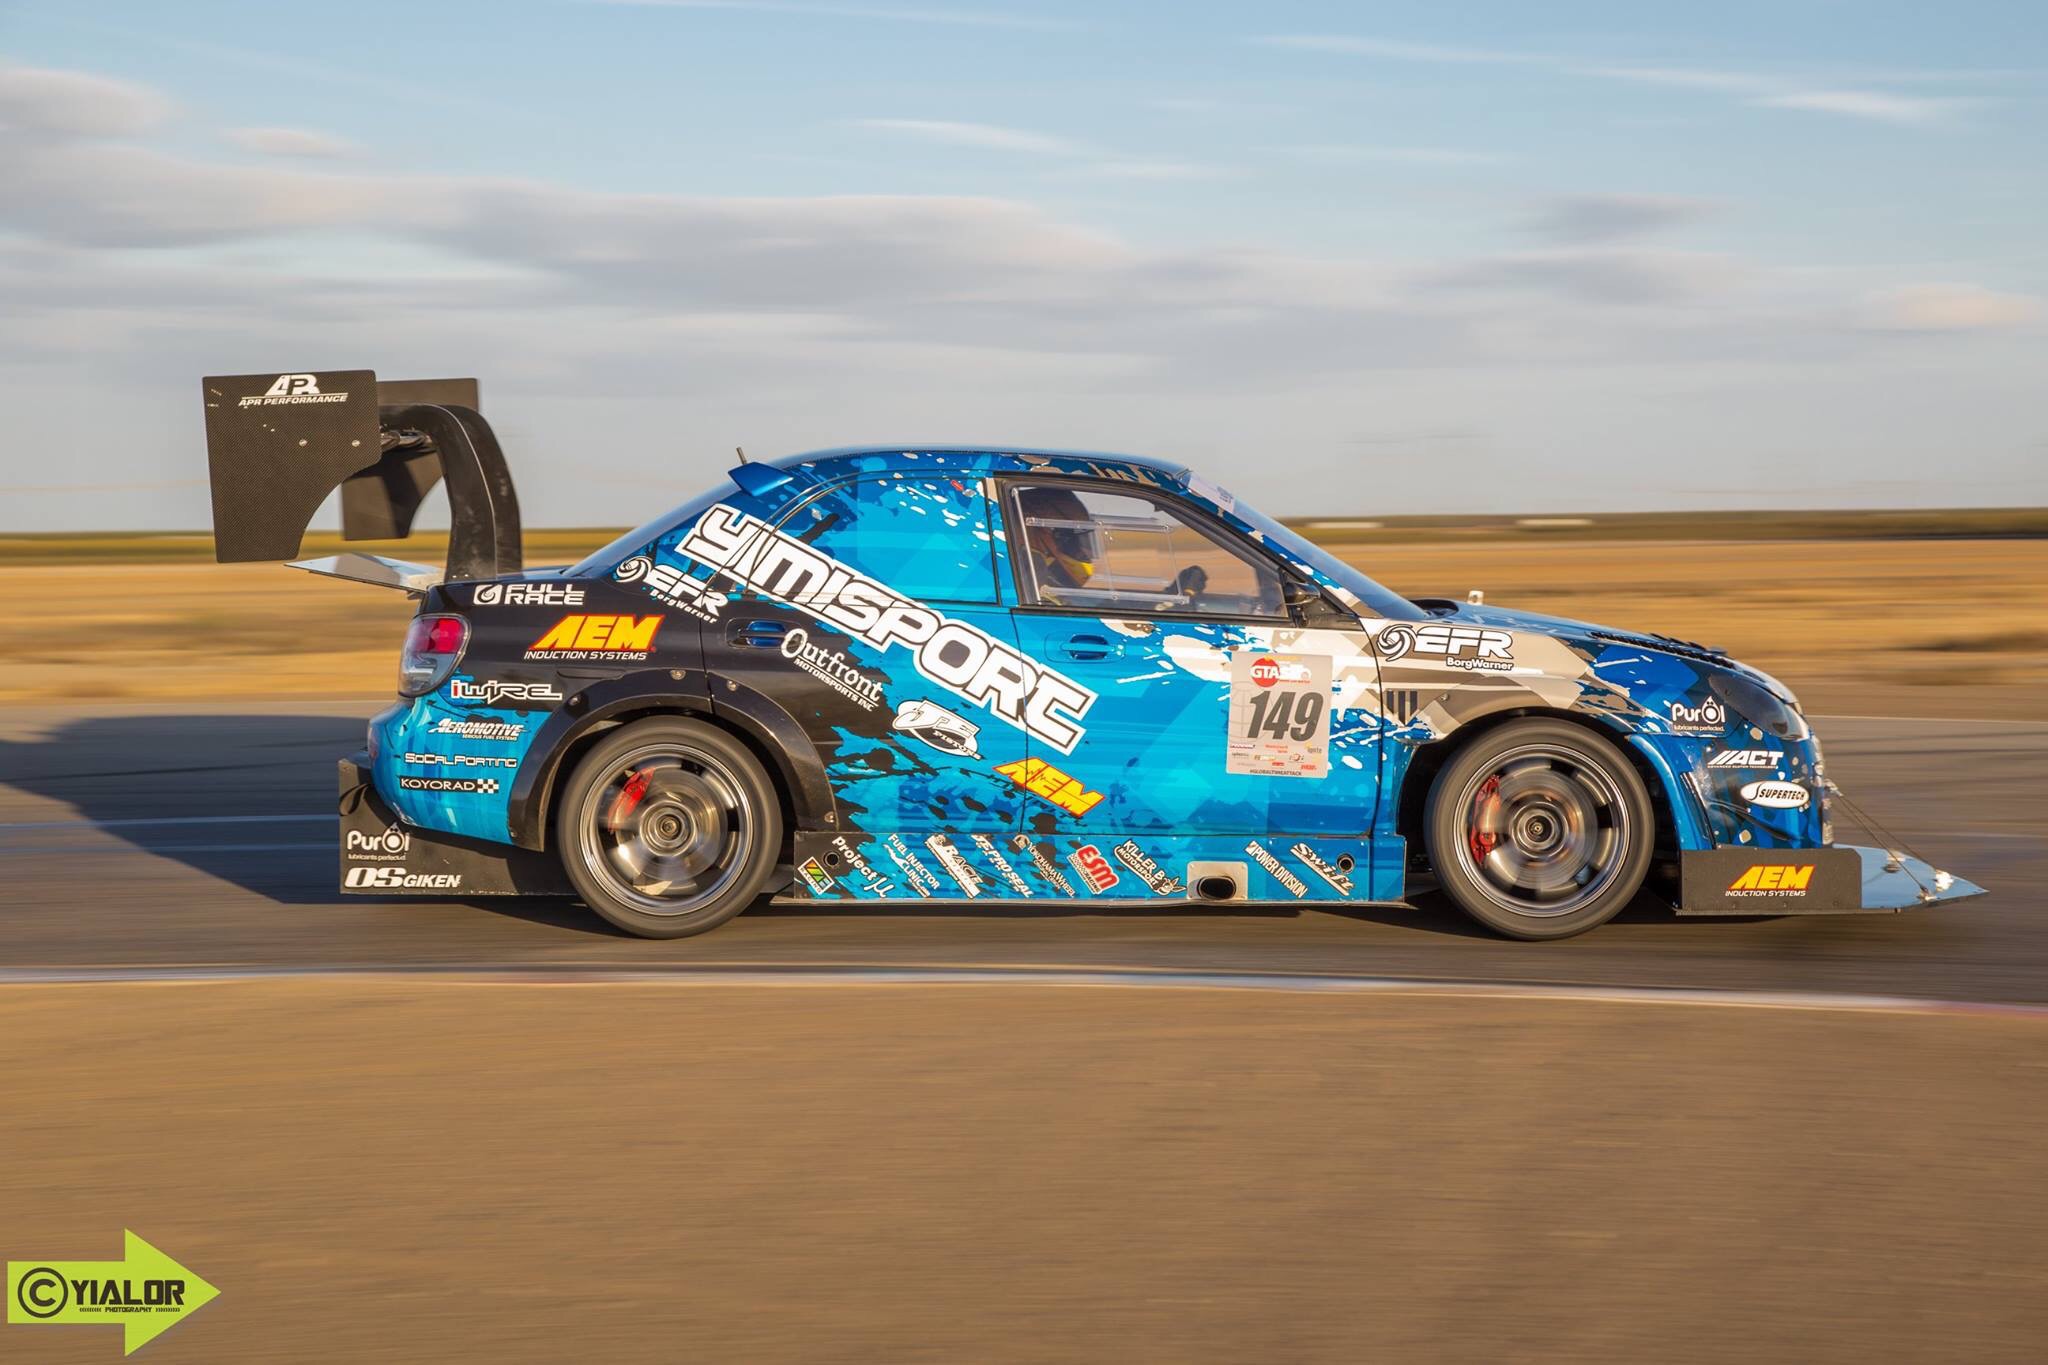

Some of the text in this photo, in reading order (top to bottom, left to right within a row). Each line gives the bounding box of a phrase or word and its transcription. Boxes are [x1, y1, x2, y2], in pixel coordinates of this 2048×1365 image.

[238, 394, 348, 407] APR PERFORMANCE
[504, 594, 585, 606] RACE
[505, 583, 585, 595] FULL
[643, 564, 729, 617] EFR
[650, 588, 718, 624] BorgWarner
[529, 614, 666, 651] AEM
[1414, 625, 1514, 660] EFR
[524, 651, 648, 661] INDUCTION SYSTEMS
[781, 628, 883, 702] Outfront
[1251, 665, 1280, 679] GTA
[1446, 656, 1514, 671] BorgWarner
[793, 658, 875, 712] MOTORSPORTS INC
[428, 717, 526, 737] AEROMOTIVE
[1247, 690, 1324, 742] 149
[932, 730, 983, 760] PISTONS
[401, 778, 476, 791] KOYORAD
[992, 757, 1105, 818] AEM
[832, 836, 878, 882] Project
[887, 833, 907, 857] FUEL
[905, 852, 941, 890] INJECTOR
[900, 860, 926, 892] CLINIC
[1077, 845, 1119, 890] ESM
[1118, 848, 1158, 888] MOTORSPORT
[1122, 839, 1165, 880] KILLER B
[1251, 846, 1309, 899] POWER DIVISION
[1293, 842, 1356, 891] Swift
[1728, 864, 1817, 890] AEM
[1768, 890, 1807, 898] SYSTEMS
